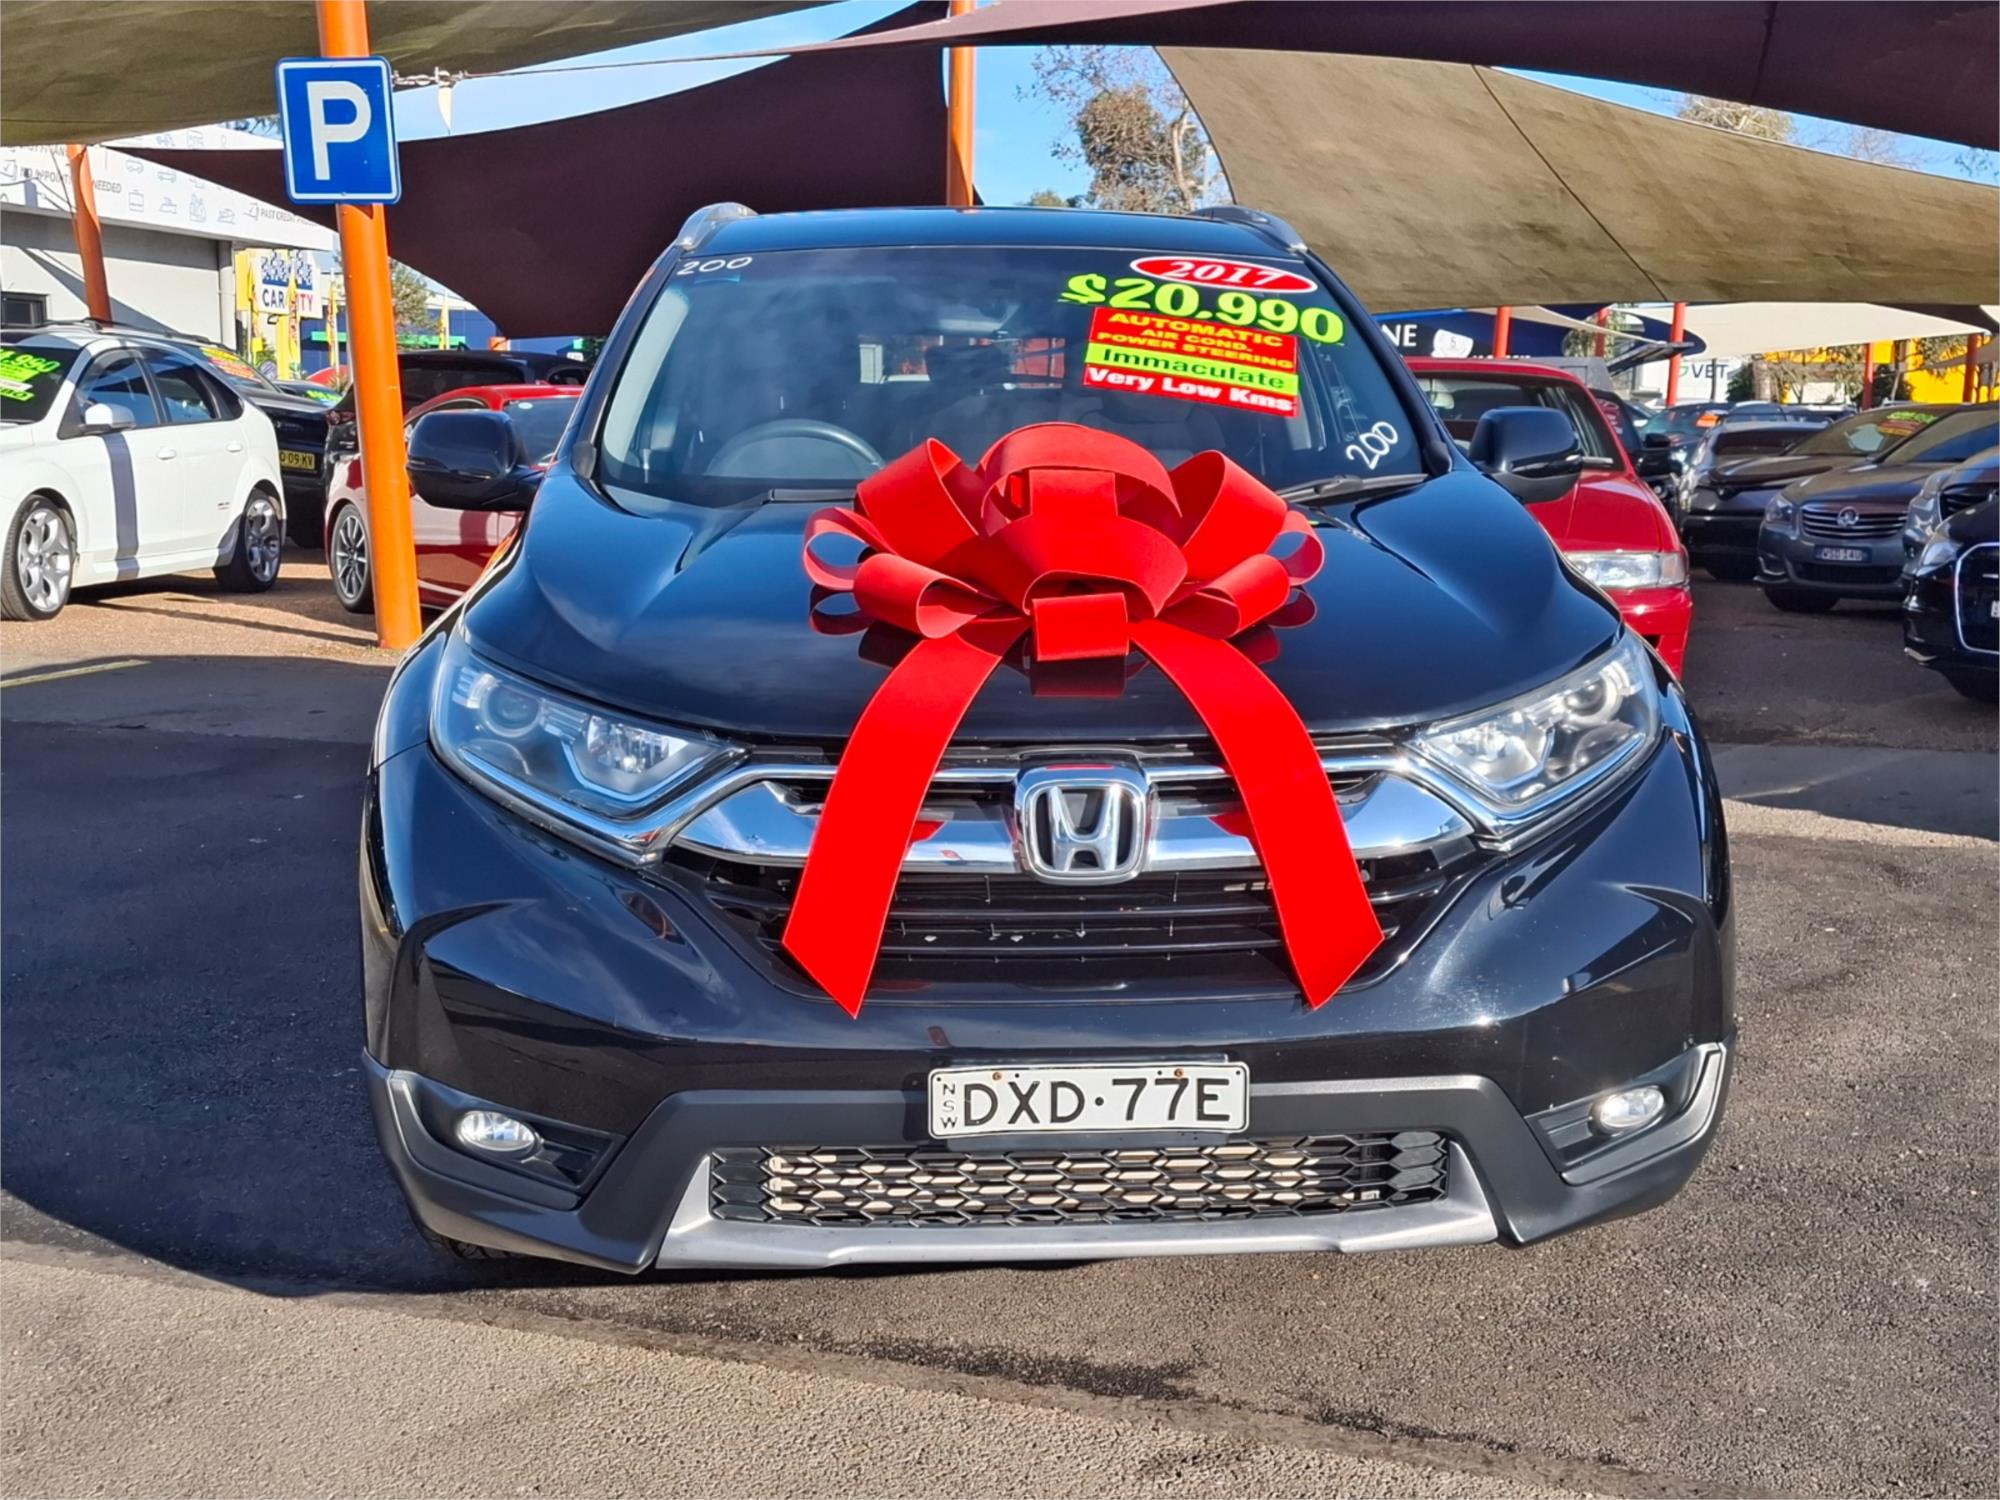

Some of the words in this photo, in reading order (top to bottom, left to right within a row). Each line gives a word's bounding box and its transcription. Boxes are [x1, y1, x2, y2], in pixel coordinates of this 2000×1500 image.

[306, 80, 372, 181] P
[676, 255, 753, 276] 200
[1162, 260, 1284, 287] 2017
[262, 288, 285, 308] CAR
[1058, 273, 1345, 345] $20.990
[1108, 312, 1284, 347] AUTOMATIC
[1141, 328, 1179, 342] AIR
[1190, 336, 1254, 353] COND.
[1097, 331, 1175, 351] POWER
[1182, 343, 1294, 369] STEERING
[1103, 348, 1285, 389] Immaculate
[1691, 363, 1729, 379] VET
[1088, 367, 1155, 391] Very
[1162, 376, 1221, 402] Low
[1229, 387, 1294, 412] Kms
[1345, 420, 1399, 470] 200
